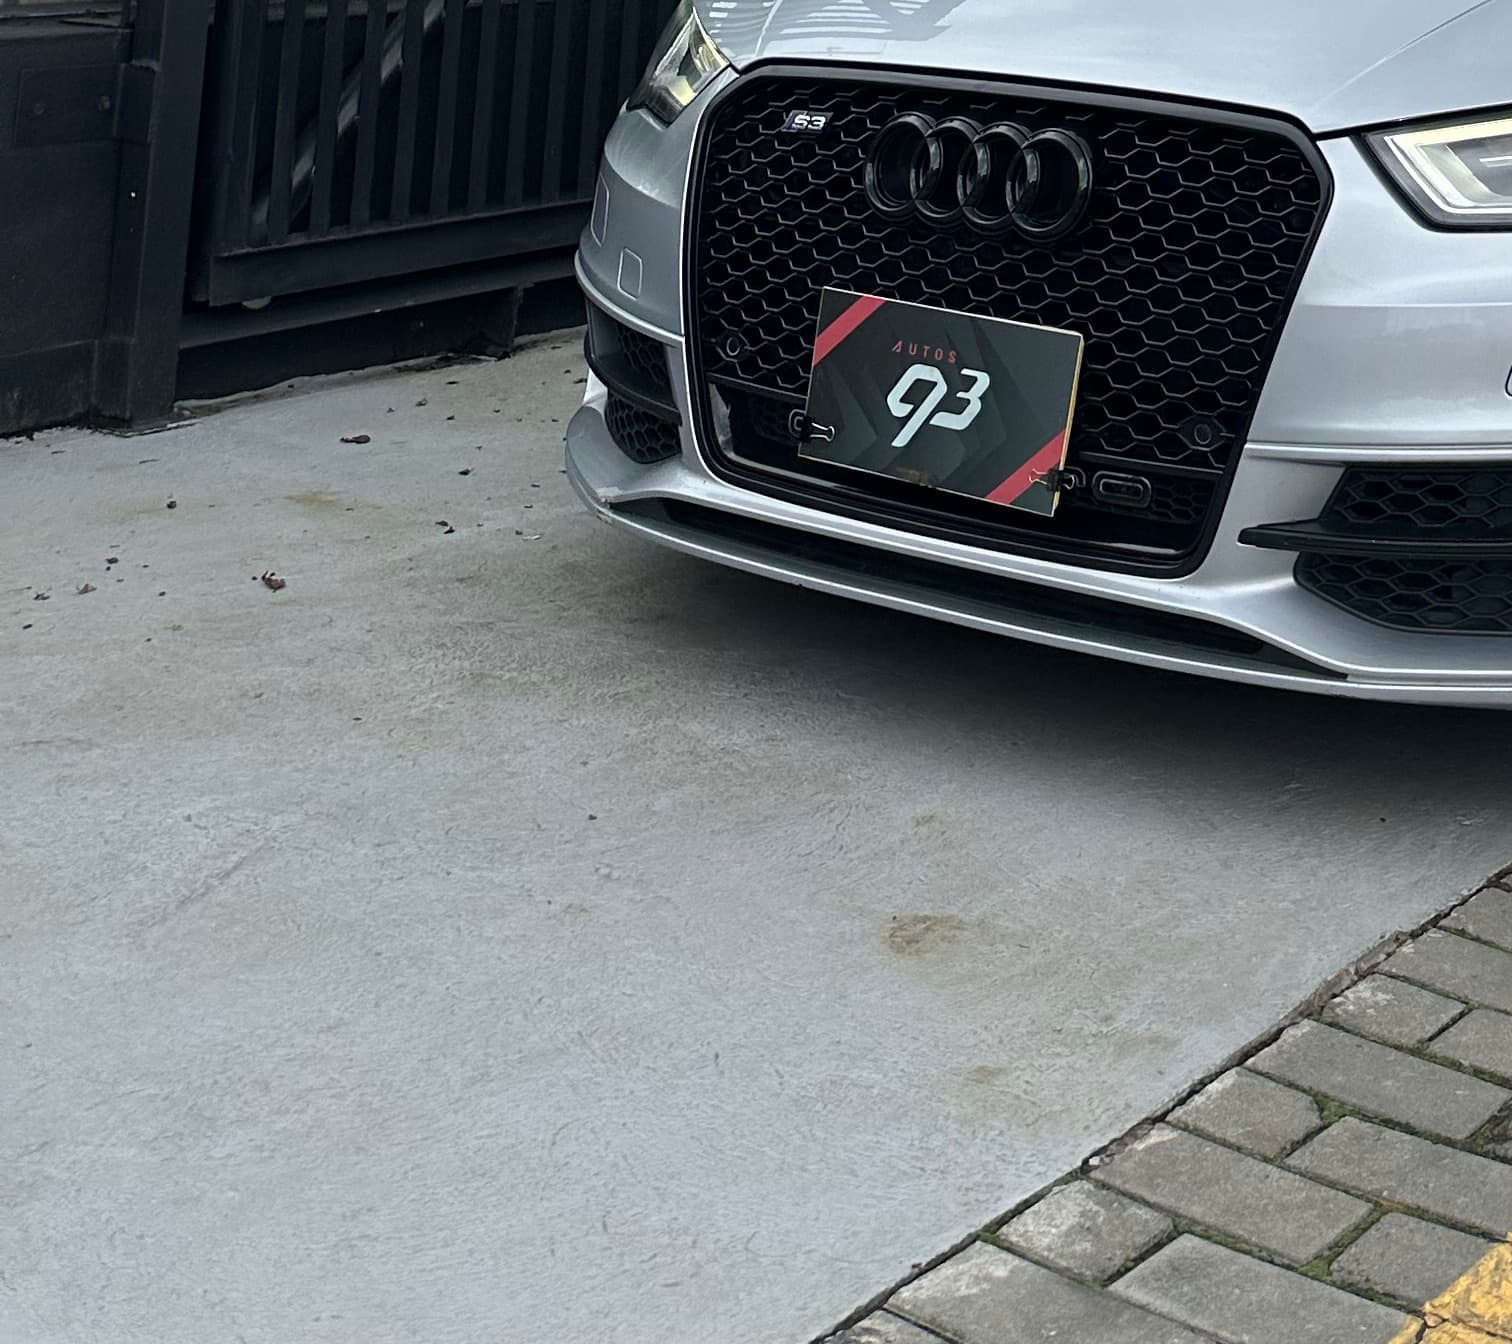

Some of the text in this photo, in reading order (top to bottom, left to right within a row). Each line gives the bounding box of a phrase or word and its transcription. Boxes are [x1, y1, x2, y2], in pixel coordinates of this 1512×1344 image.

[791, 113, 826, 131] S3
[891, 339, 958, 365] AUTOS
[886, 363, 991, 448] 93
